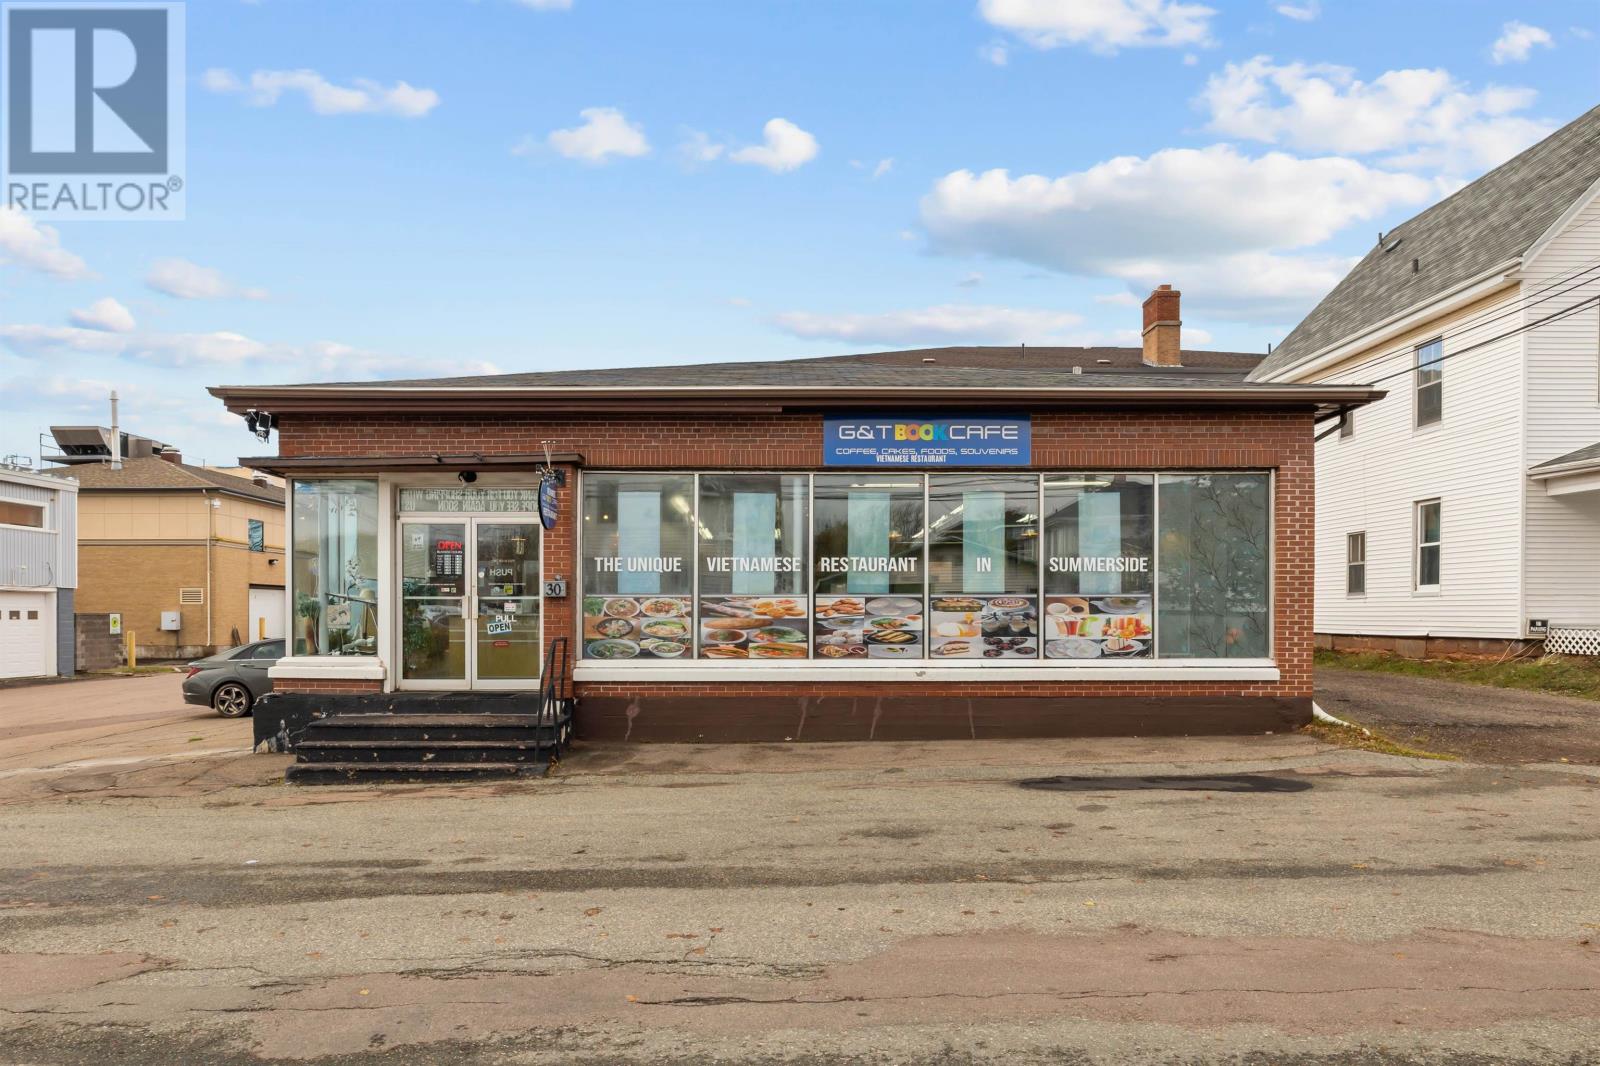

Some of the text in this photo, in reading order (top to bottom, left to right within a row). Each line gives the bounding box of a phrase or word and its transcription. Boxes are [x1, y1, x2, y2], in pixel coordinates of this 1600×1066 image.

[838, 423, 1019, 441] G&T BOOK CAFE
[836, 447, 1019, 455] COFFEE, CAKES, FOODS, SOUVENIRS
[875, 454, 946, 463] VIETNAMESE RESTAURANT
[438, 541, 463, 550] OPEN
[594, 556, 1149, 573] THE UNIQUE VIETNAMESE RESTAURANT IN SUMMERSIDE
[546, 583, 562, 596] 30
[495, 614, 517, 623] PULL
[488, 622, 511, 632] OPEN
